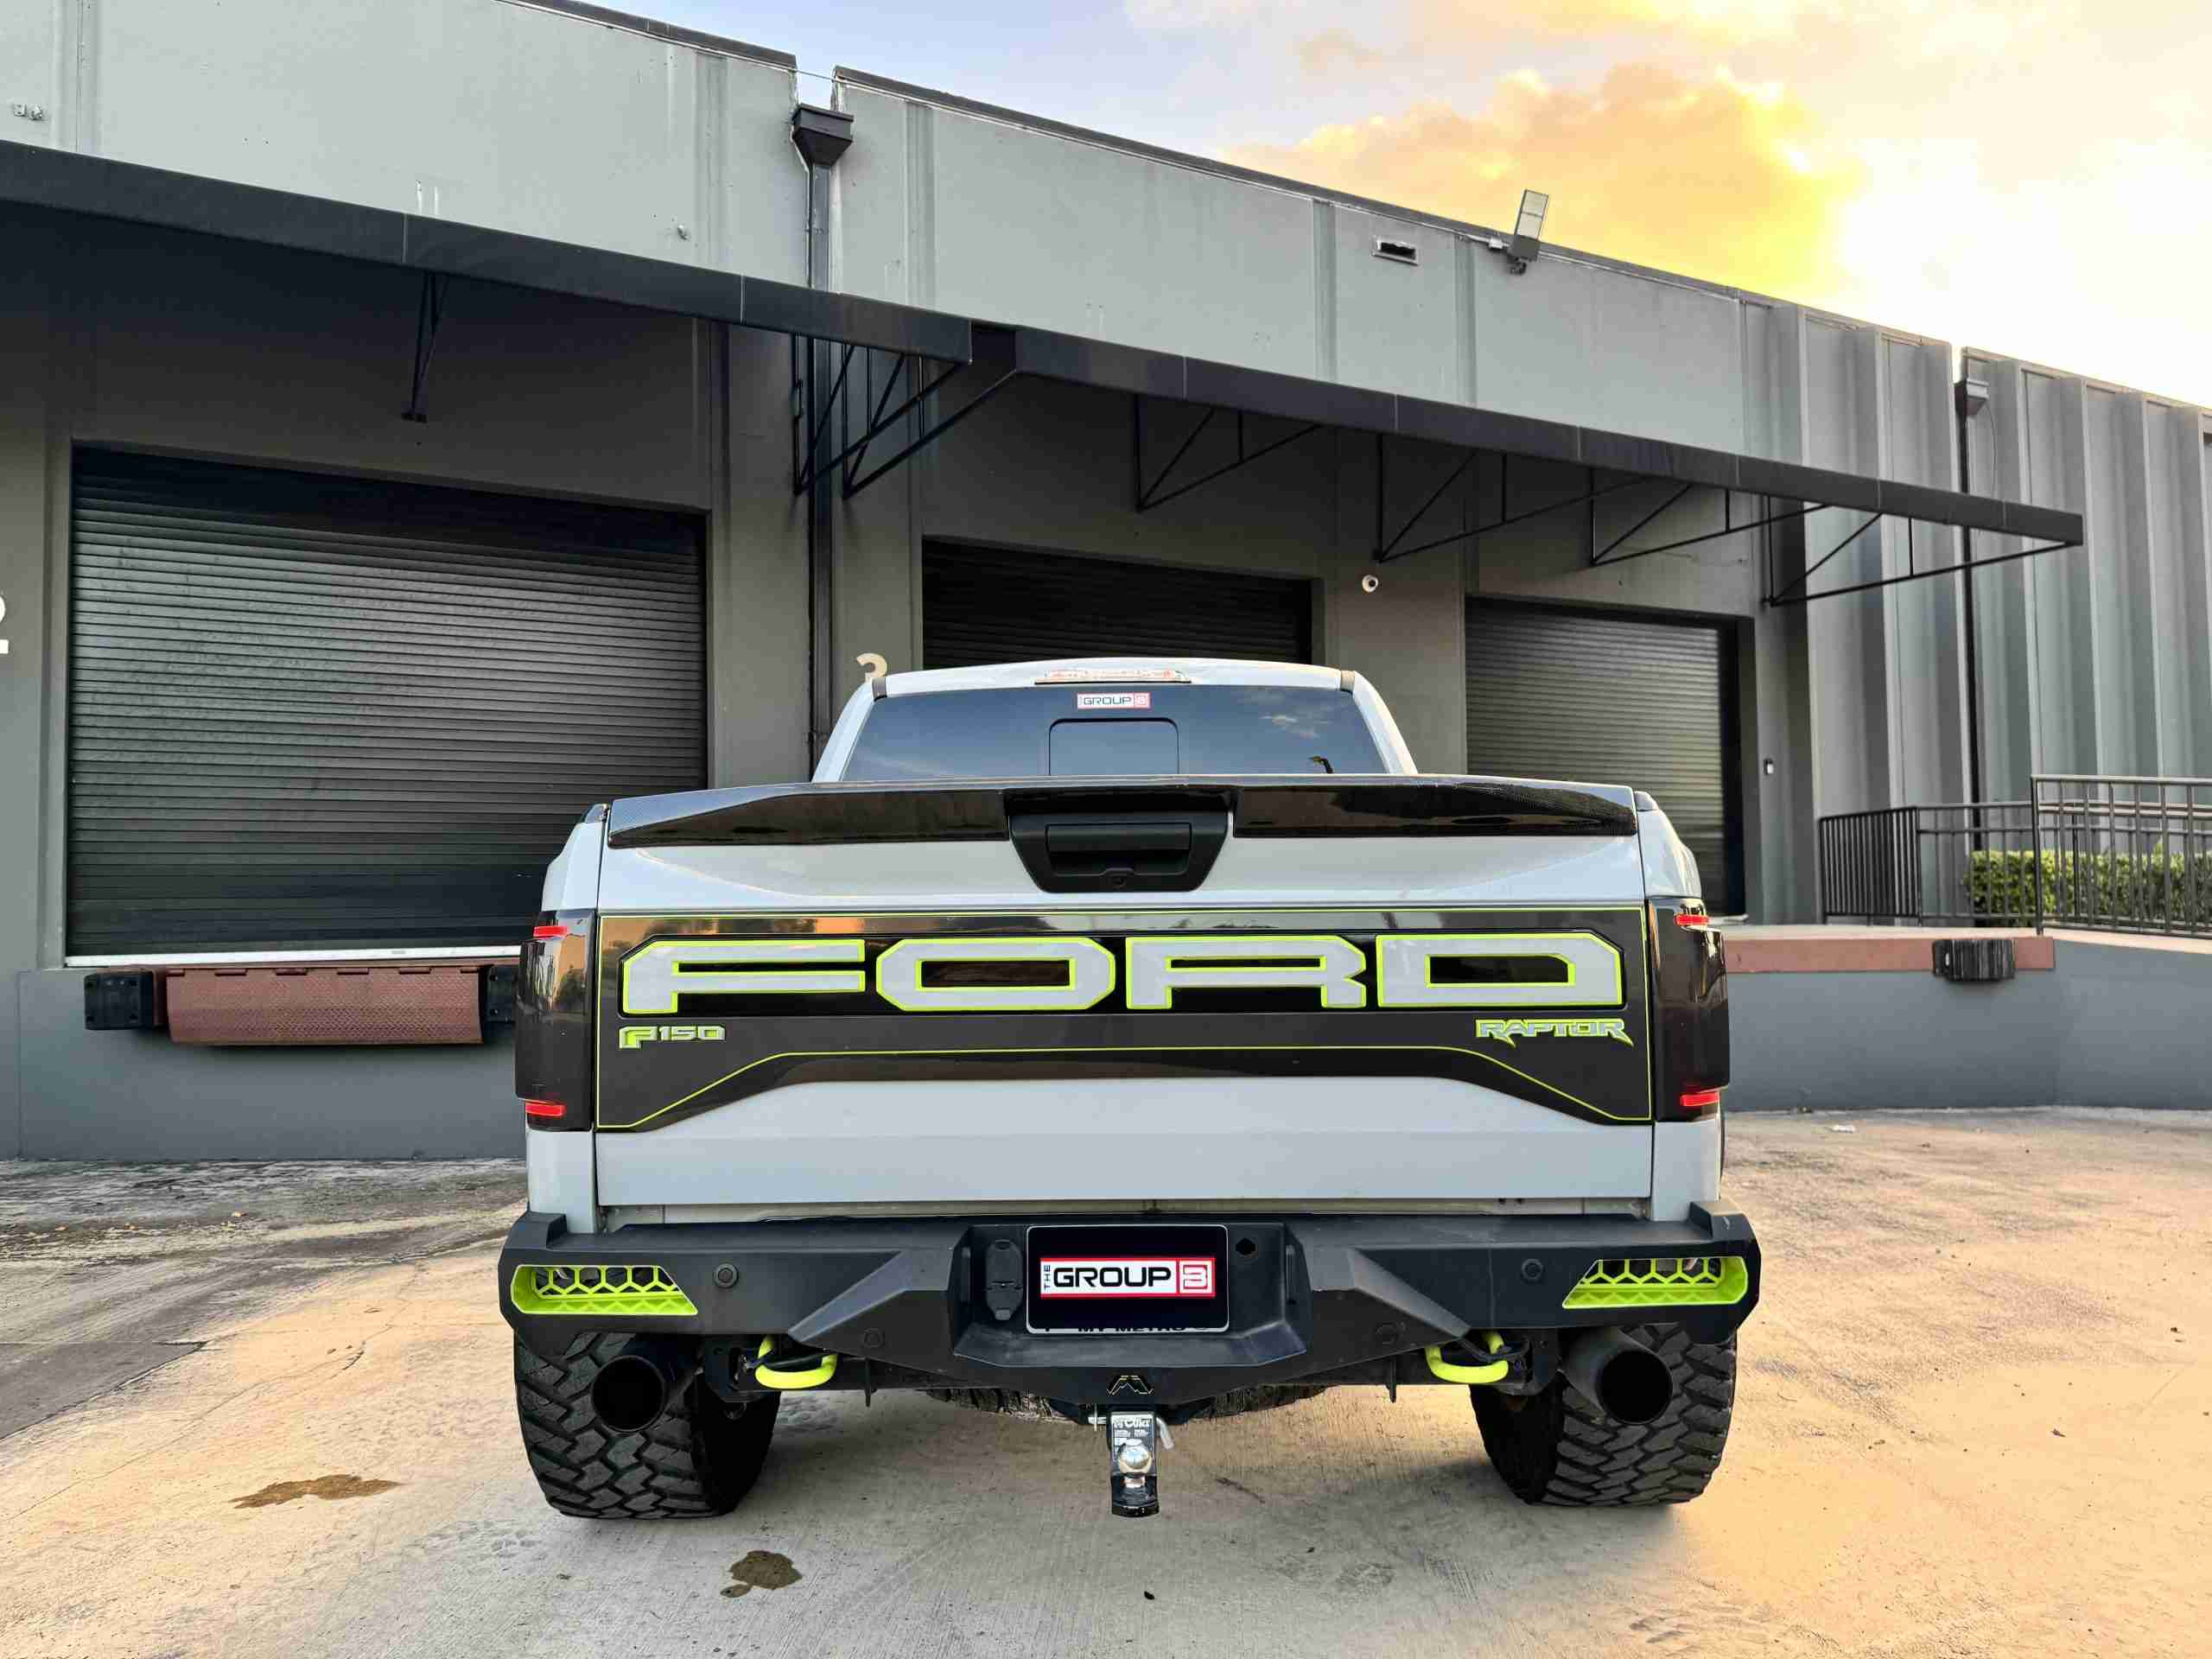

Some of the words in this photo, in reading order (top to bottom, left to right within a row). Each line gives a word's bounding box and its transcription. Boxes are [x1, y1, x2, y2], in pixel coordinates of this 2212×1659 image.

[1084, 696, 1132, 706] GROUP
[622, 931, 1624, 1014] FORD
[1475, 1018, 1634, 1047] RAPTOR
[1043, 1264, 1052, 1290] THE
[1052, 1266, 1172, 1287] GROUP
